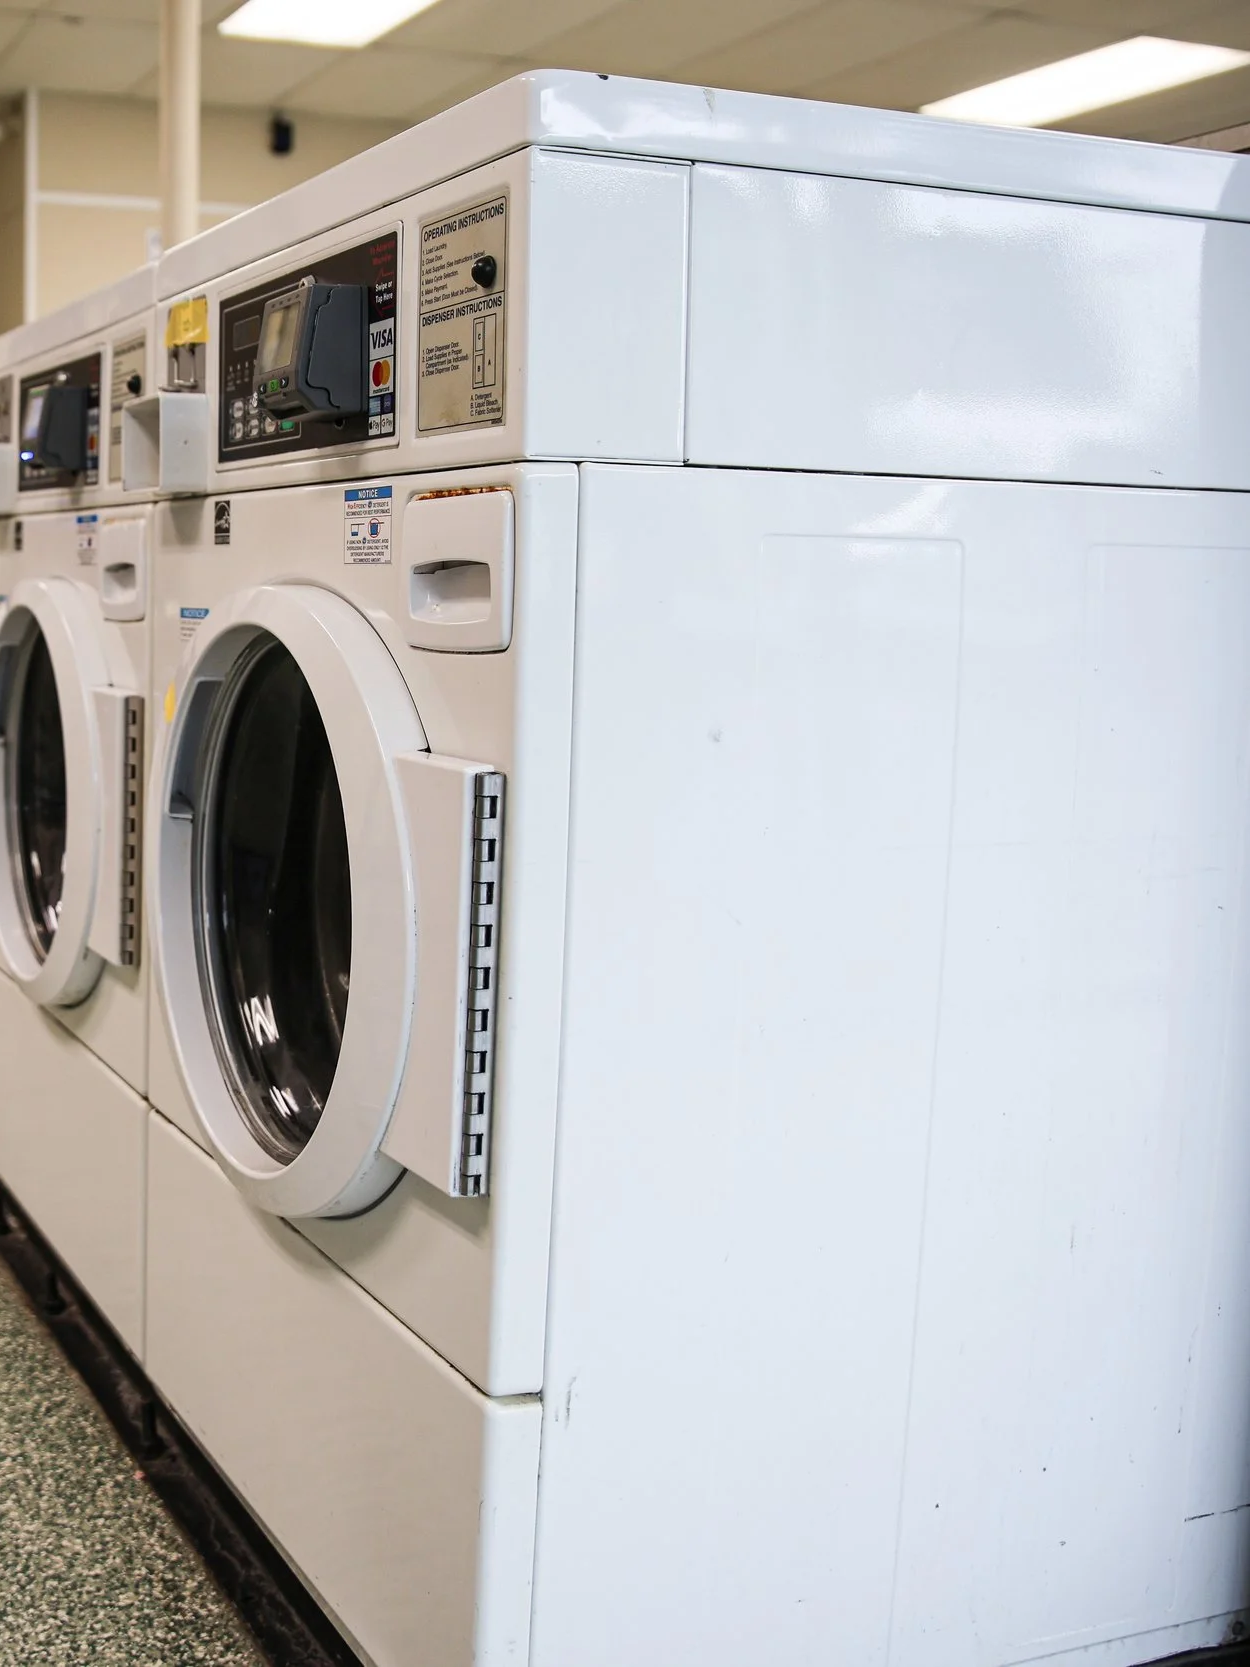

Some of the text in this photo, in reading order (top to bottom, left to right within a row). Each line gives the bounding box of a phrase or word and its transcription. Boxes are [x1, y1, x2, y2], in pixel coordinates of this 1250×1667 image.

[424, 203, 504, 242] OPERATING INSTRUCTIONS
[426, 246, 434, 255] Load
[426, 257, 434, 265] Close
[432, 263, 446, 273] Supplies
[454, 254, 473, 266] Instructions
[425, 277, 434, 285] Make
[434, 274, 443, 283] Cycle
[376, 280, 393, 292] Swipe or
[425, 287, 433, 295] Make
[375, 293, 393, 304] Tap Here
[451, 290, 459, 298] Must
[422, 296, 502, 327] DISPENSER INSTRUCTIONS
[371, 330, 393, 350] VISA
[426, 346, 434, 355] Open
[435, 343, 450, 353] Dispenser
[434, 352, 447, 360] Supplies
[452, 348, 462, 356] Proper
[426, 359, 446, 369] Compartment
[435, 366, 450, 374] Dispenser
[372, 386, 390, 394] mastercard
[475, 392, 492, 400] Detergent
[475, 401, 485, 409] Liquid
[475, 408, 486, 416] Fabric
[486, 406, 501, 414] Softener
[372, 420, 380, 430] Pay
[382, 418, 385, 427] G
[358, 490, 378, 498] NOTICE
